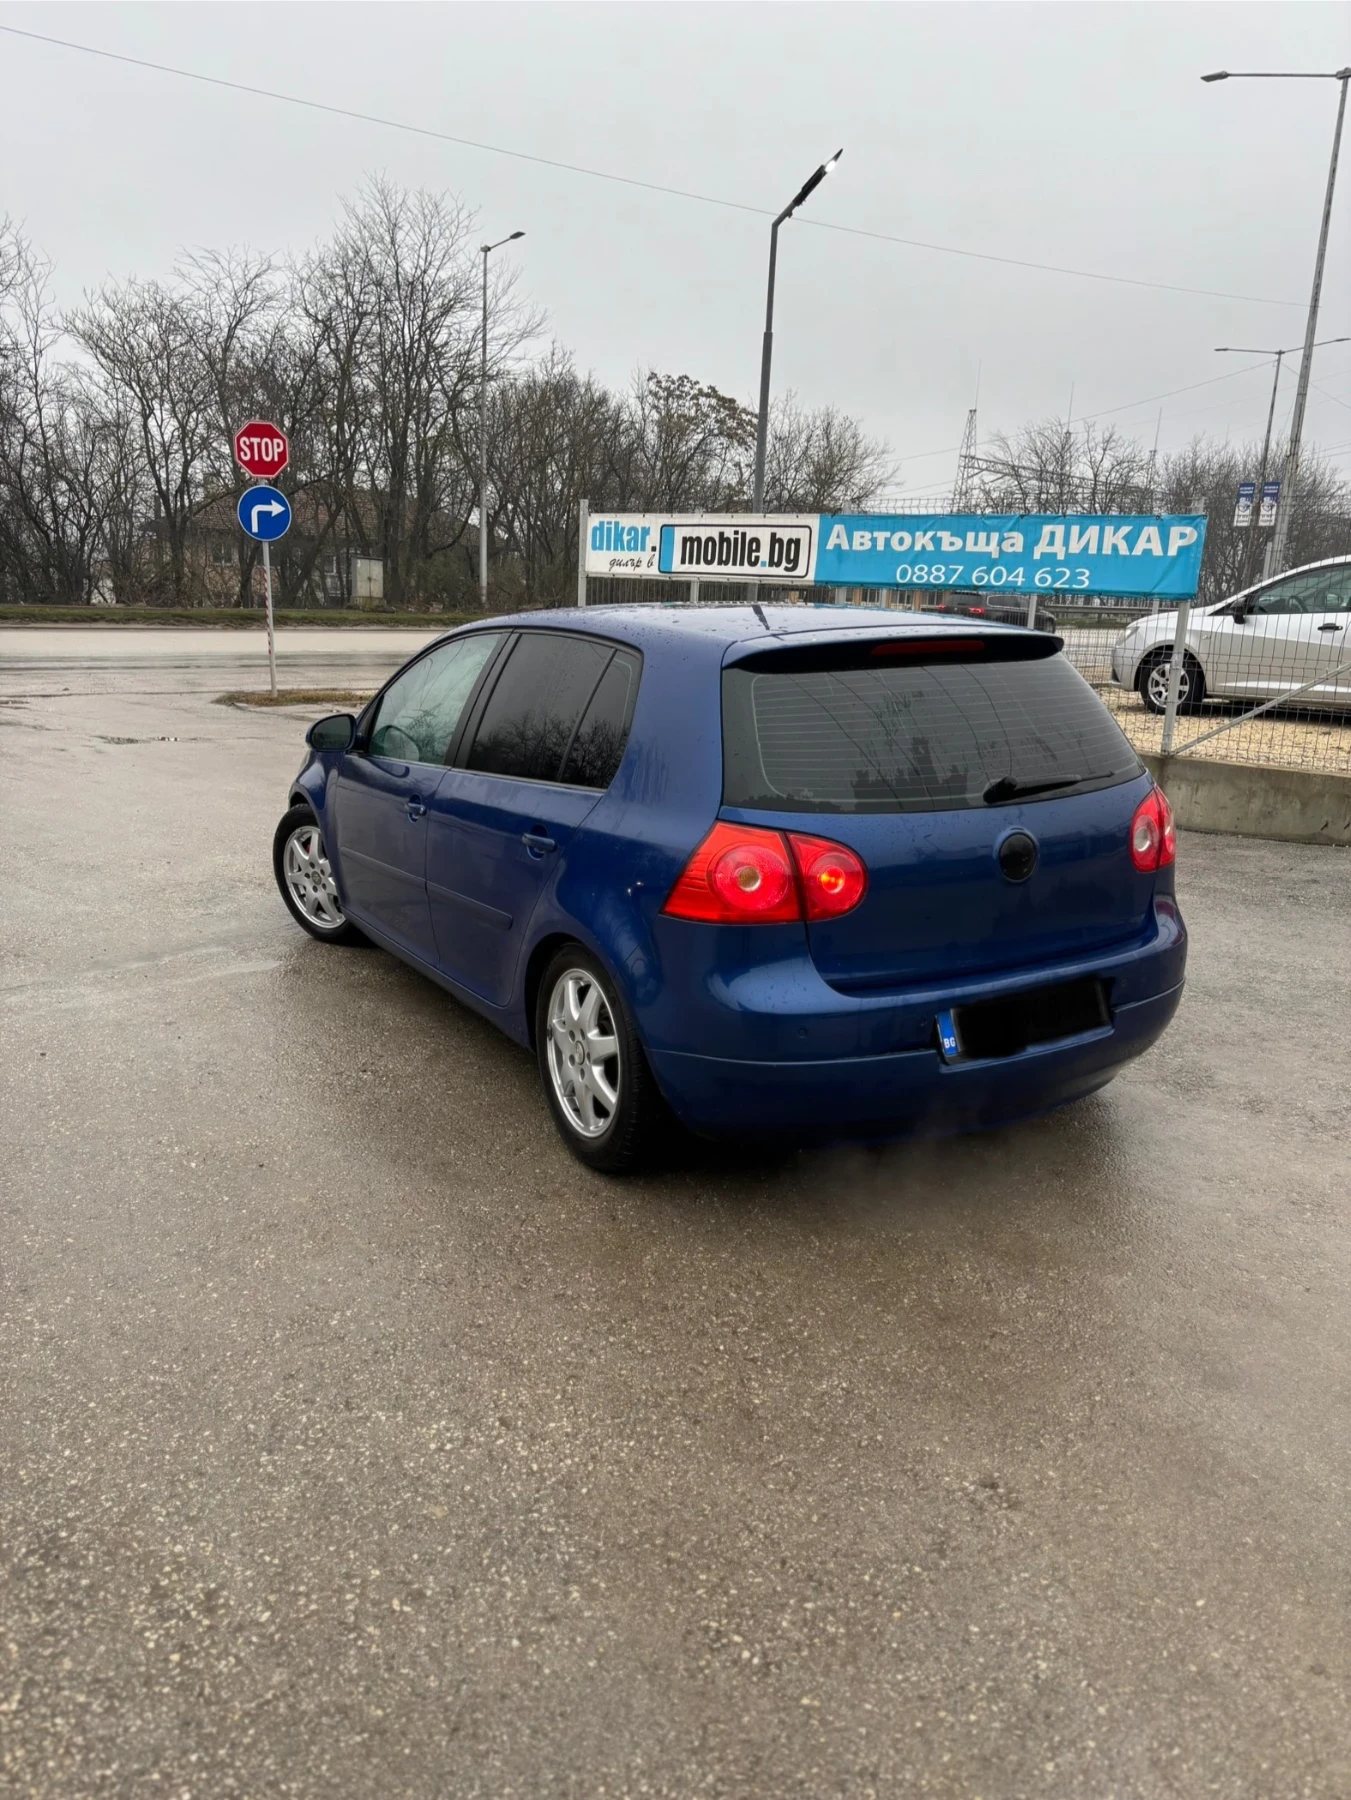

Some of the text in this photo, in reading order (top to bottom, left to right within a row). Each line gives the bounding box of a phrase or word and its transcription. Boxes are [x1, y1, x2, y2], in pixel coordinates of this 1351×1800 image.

[239, 436, 284, 462] STOP
[680, 530, 801, 572] mobile.bg
[826, 524, 1198, 560] Автокъща ДИКАР
[896, 564, 1090, 588] 0887 604 623
[943, 1037, 956, 1049] BG
